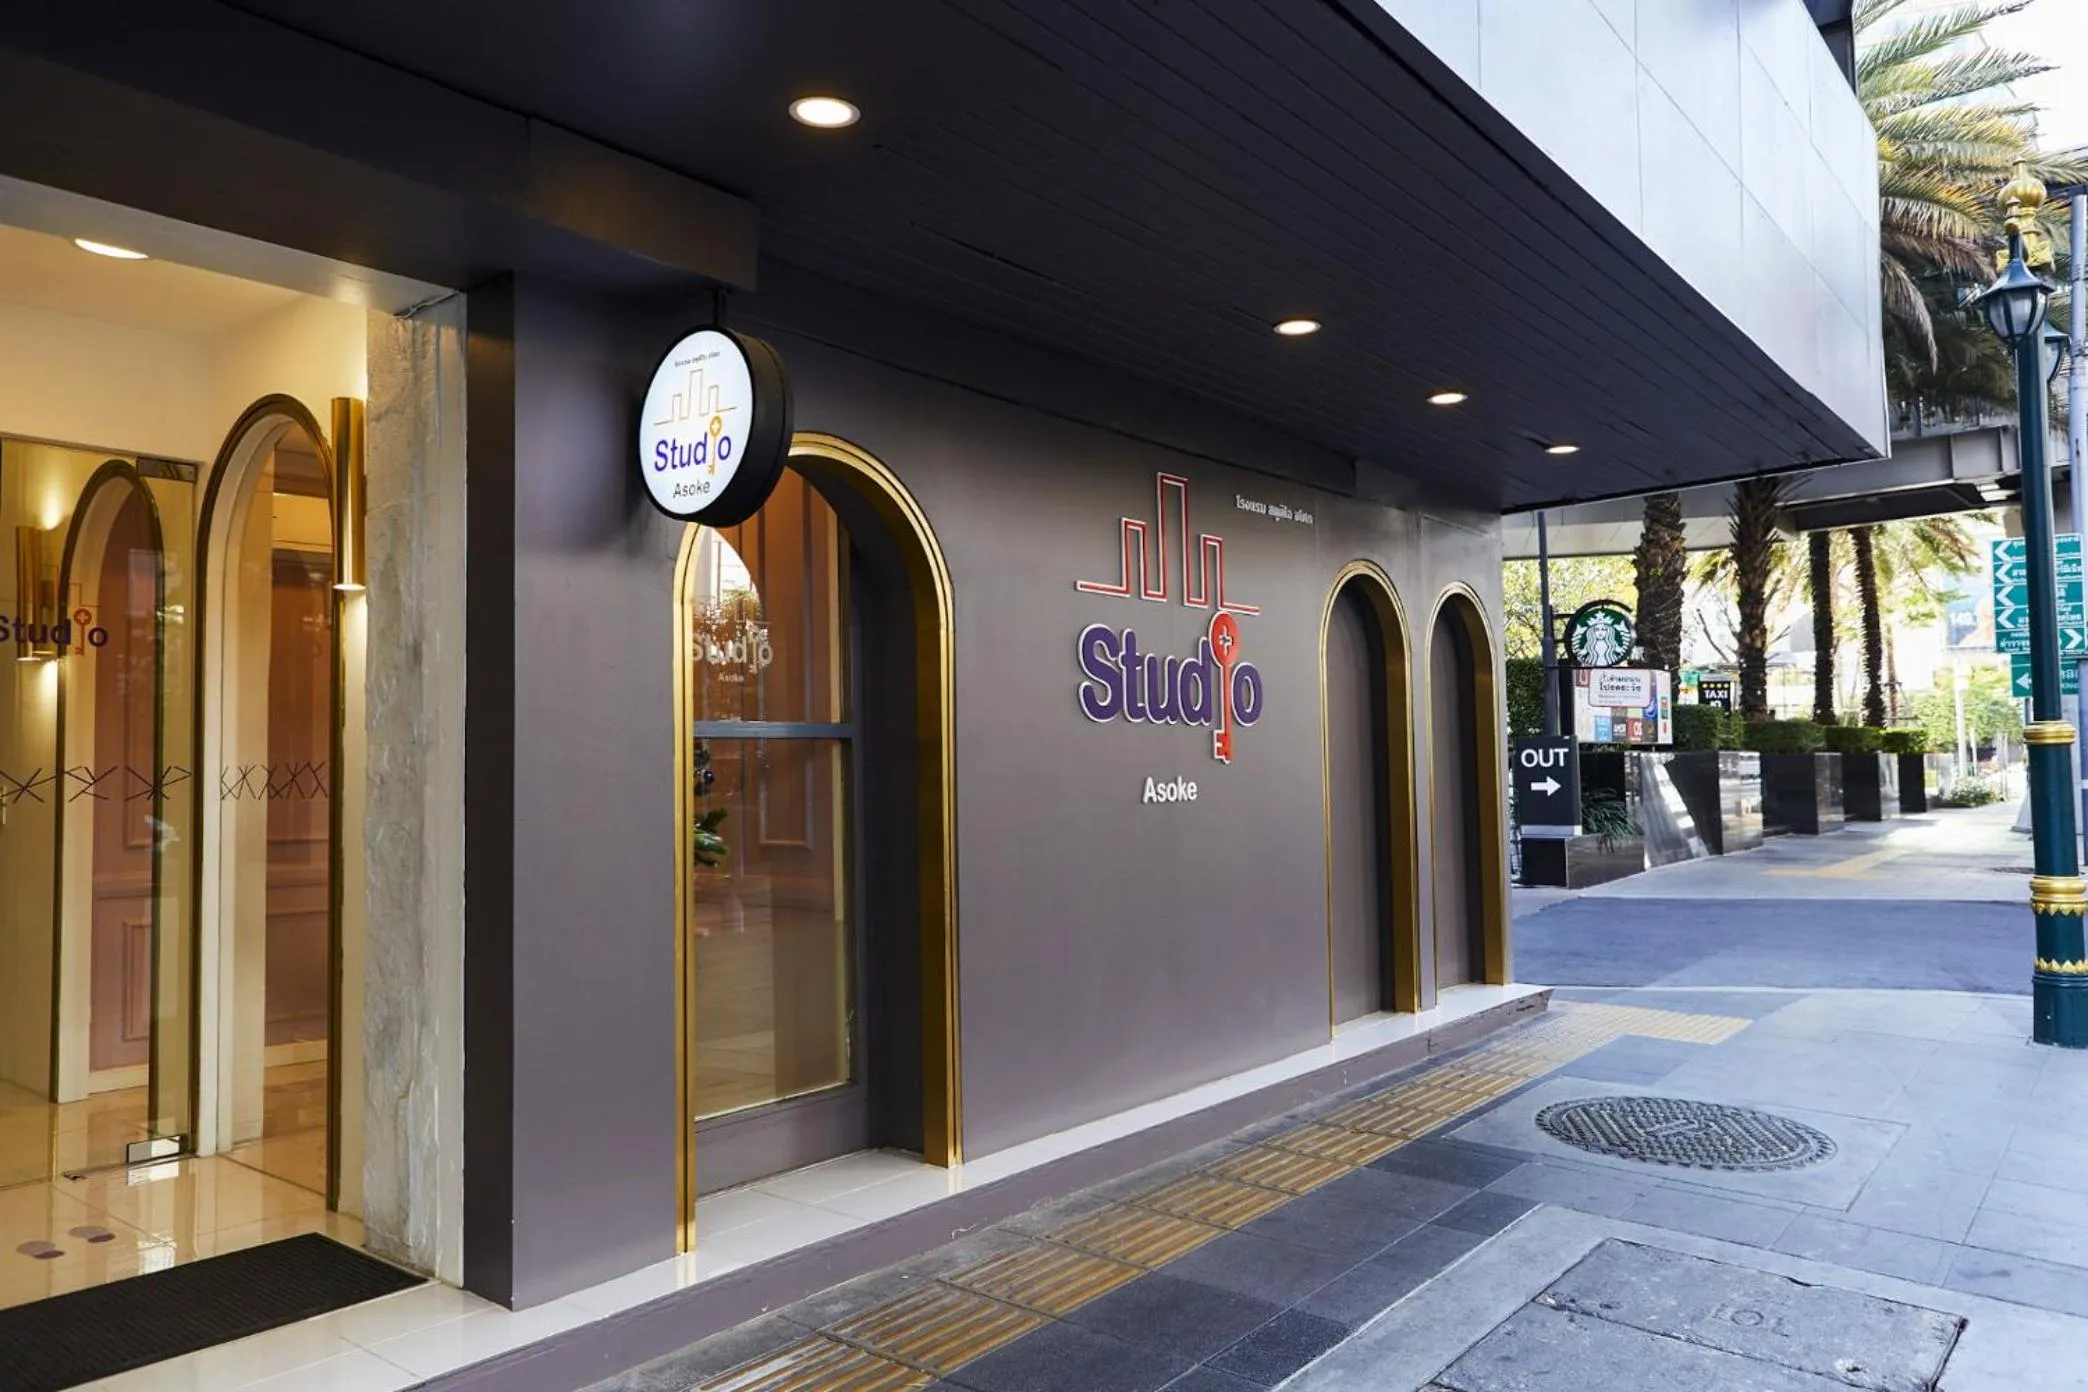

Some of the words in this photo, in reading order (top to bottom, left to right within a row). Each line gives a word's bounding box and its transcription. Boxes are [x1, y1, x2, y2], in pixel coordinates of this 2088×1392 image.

[654, 416, 732, 475] Studio
[673, 480, 711, 499] Asoke
[1078, 611, 1264, 764] Studio
[1704, 689, 1729, 699] TAXI
[1521, 747, 1569, 768] OUT
[1143, 776, 1198, 804] Asoke
